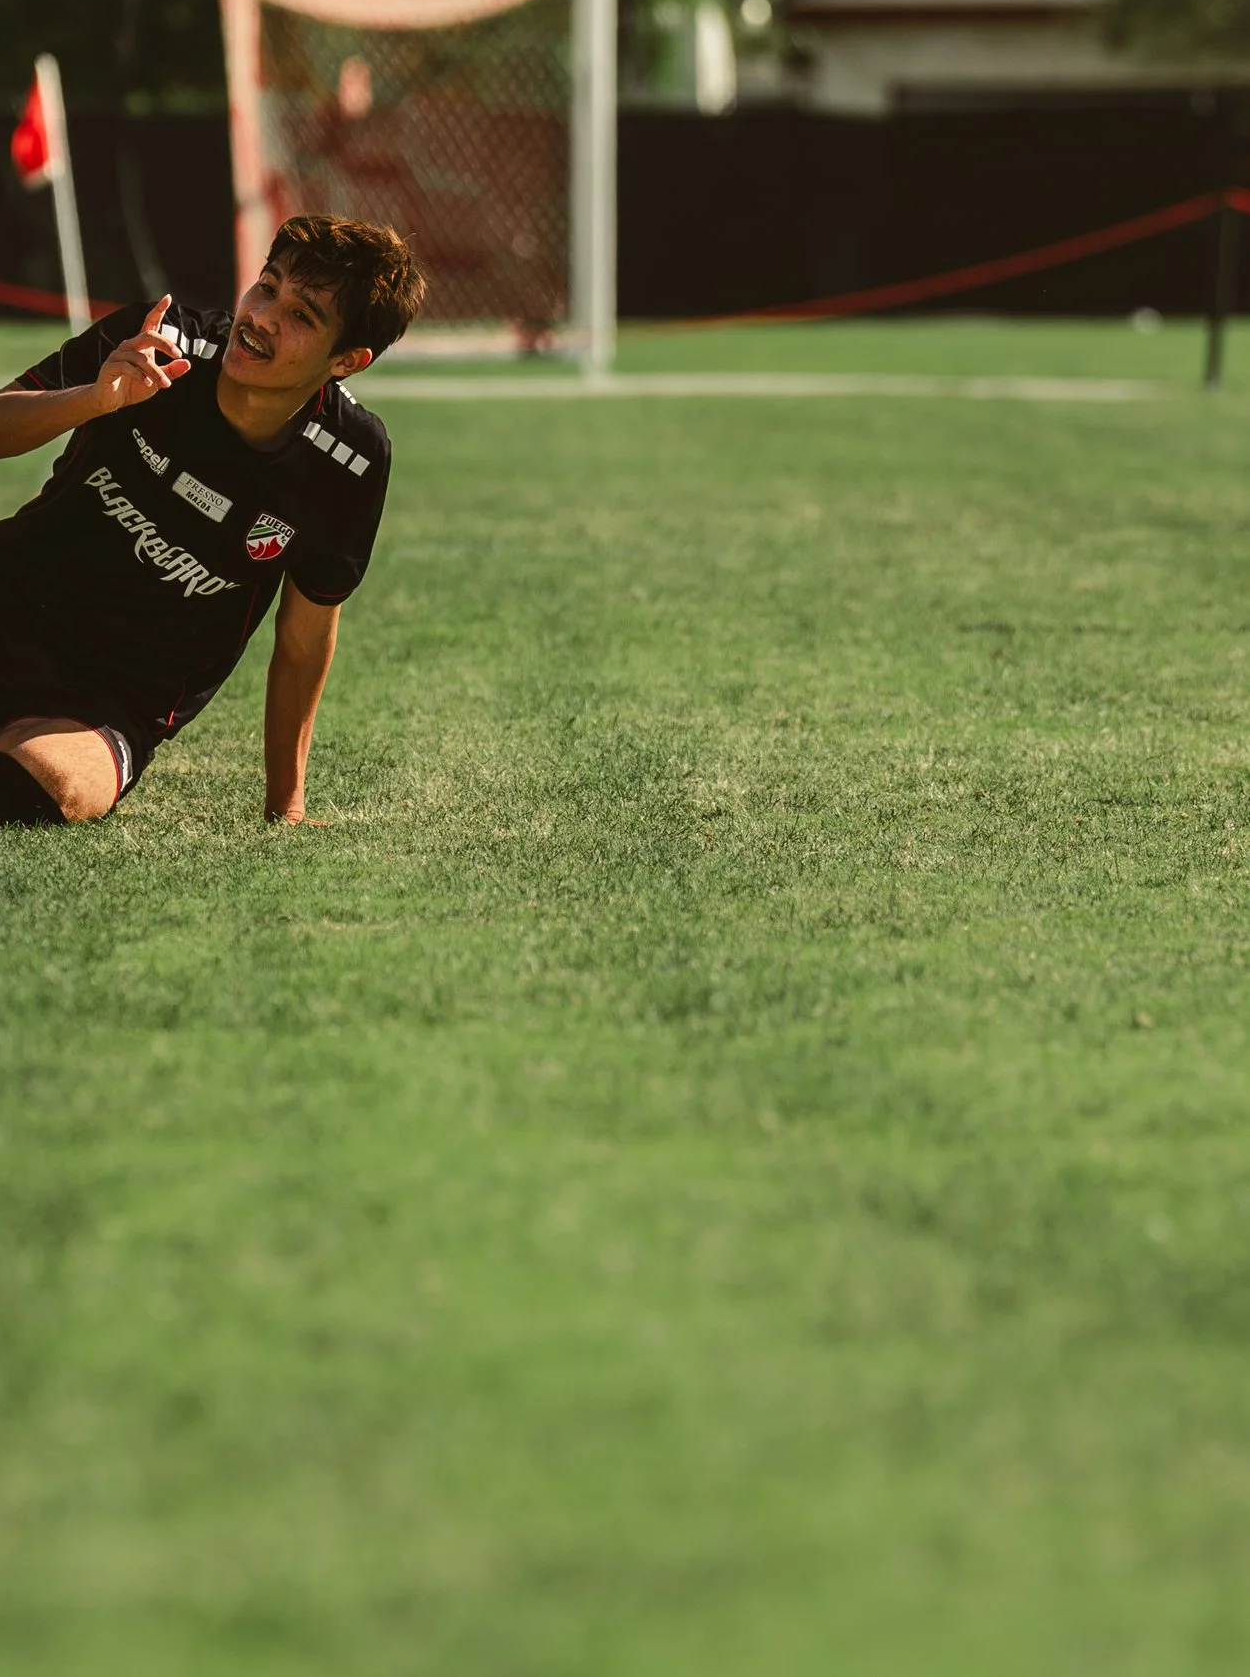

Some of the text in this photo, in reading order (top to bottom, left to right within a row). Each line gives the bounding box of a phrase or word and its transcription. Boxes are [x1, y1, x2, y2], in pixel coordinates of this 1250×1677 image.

[185, 478, 224, 507] FRESNO
[185, 491, 212, 513] MAZDA
[258, 515, 293, 538] FUEGO
